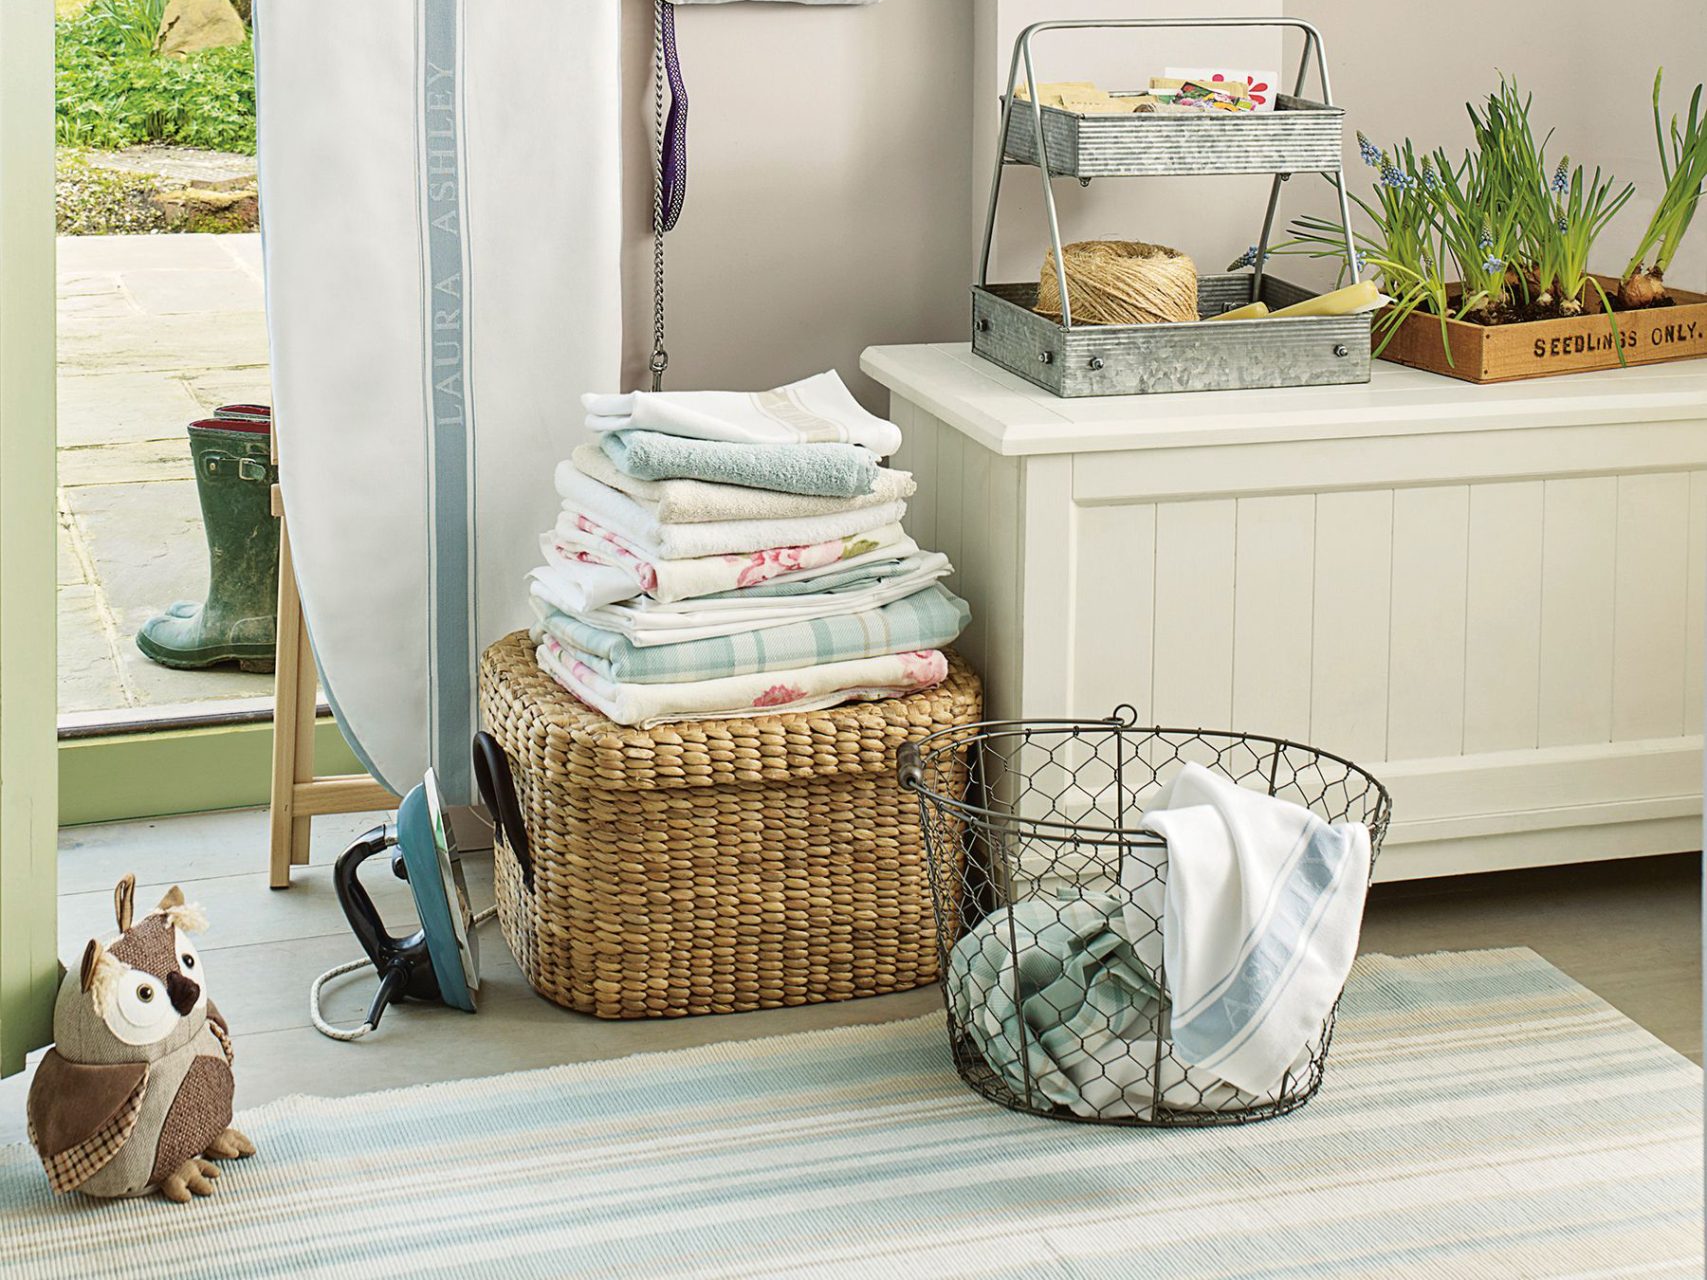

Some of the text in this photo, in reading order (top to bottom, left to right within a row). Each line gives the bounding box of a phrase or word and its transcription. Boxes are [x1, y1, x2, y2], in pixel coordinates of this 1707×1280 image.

[427, 62, 465, 428] LAURA ASHLEY
[1651, 321, 1704, 346] ONLY.
